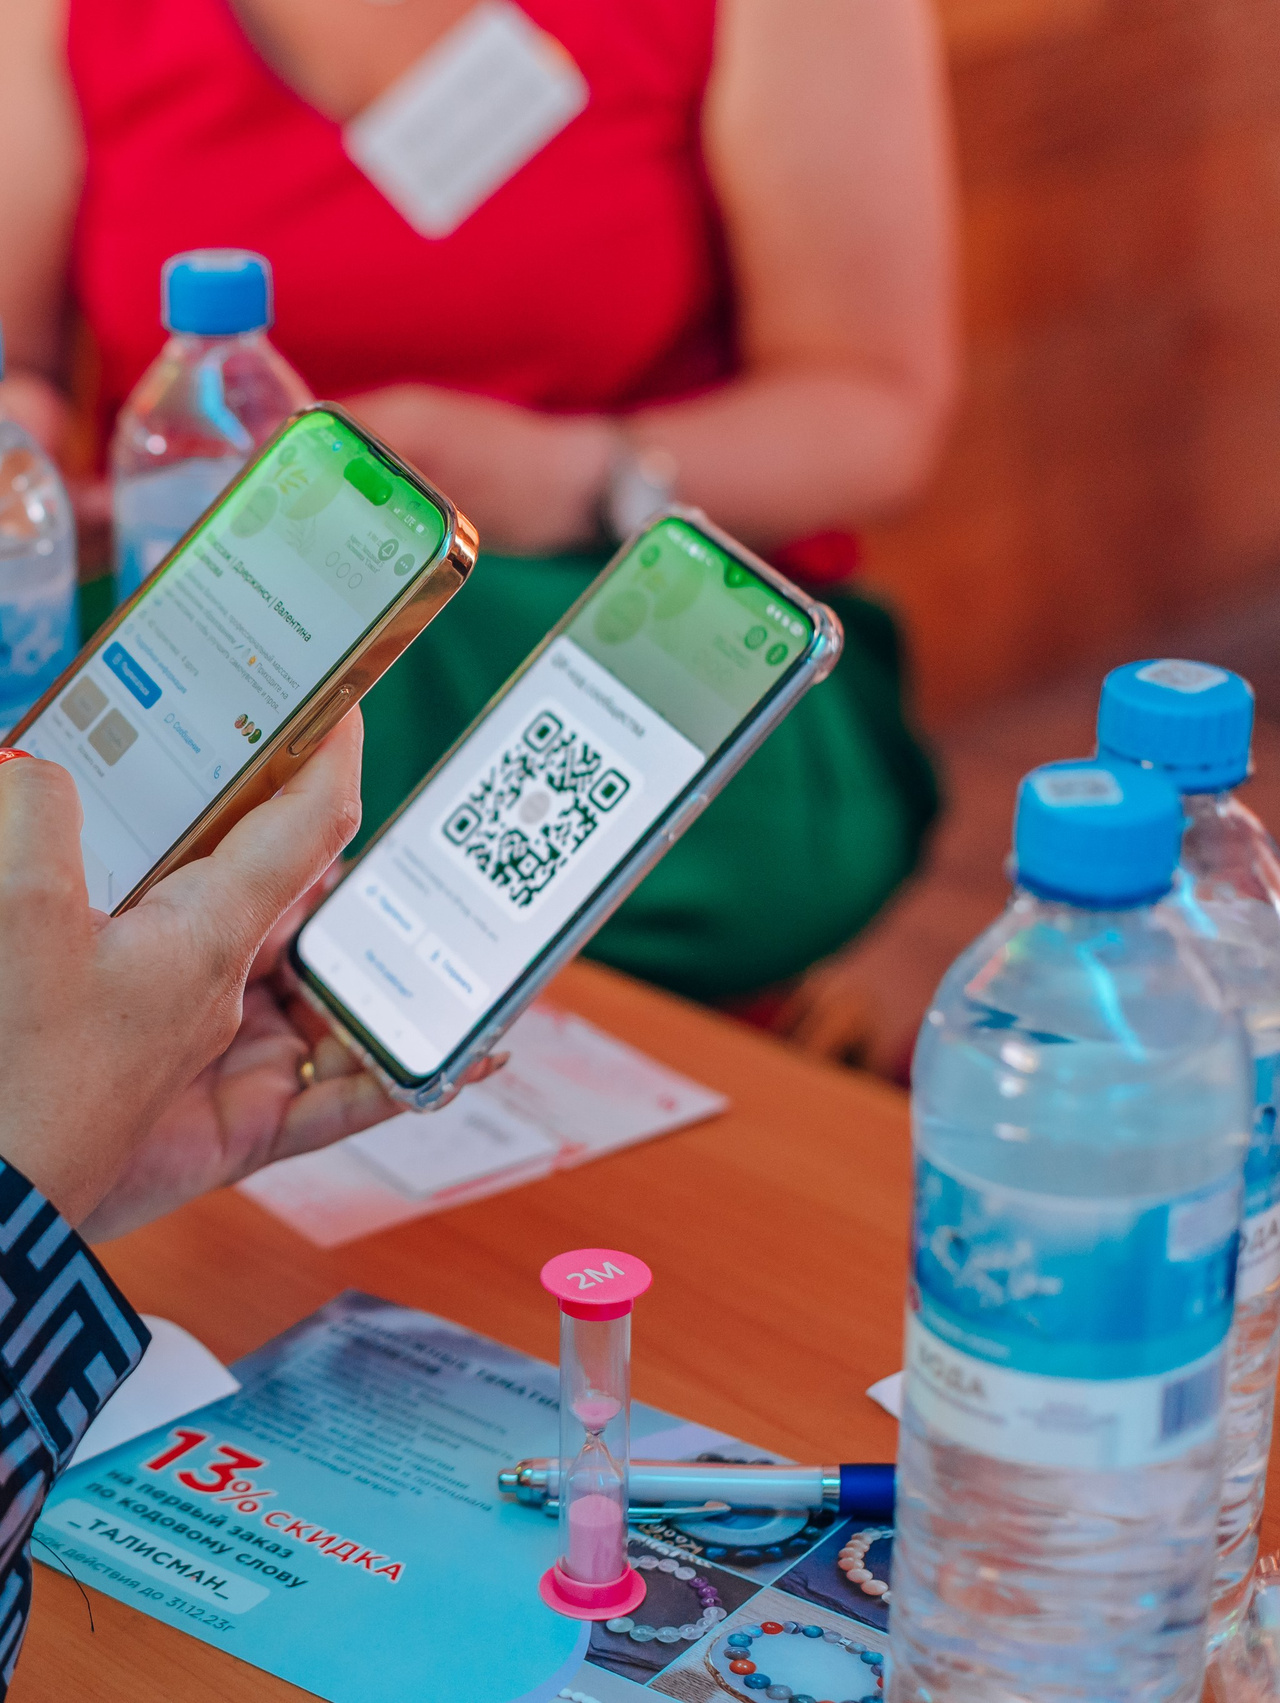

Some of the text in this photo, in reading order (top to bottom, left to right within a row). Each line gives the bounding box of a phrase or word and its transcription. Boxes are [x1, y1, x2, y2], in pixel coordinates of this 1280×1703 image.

[403, 514, 417, 527] LTE
[233, 560, 273, 603] Дзержинск
[273, 600, 312, 642] Валентина
[228, 656, 264, 694] самочувствие
[255, 661, 283, 693] Приходите
[280, 688, 289, 700] на
[271, 658, 301, 691] массажист
[173, 721, 201, 754] Сообщение
[566, 1261, 626, 1290] 2M
[107, 1469, 295, 1559] на первый заказ
[146, 1430, 405, 1582] 13% СКИДКА
[86, 1482, 309, 1589] по кодовому слову
[61, 1547, 141, 1589] действия
[138, 1586, 165, 1601] до
[165, 1596, 237, 1633] 31.12.23г
